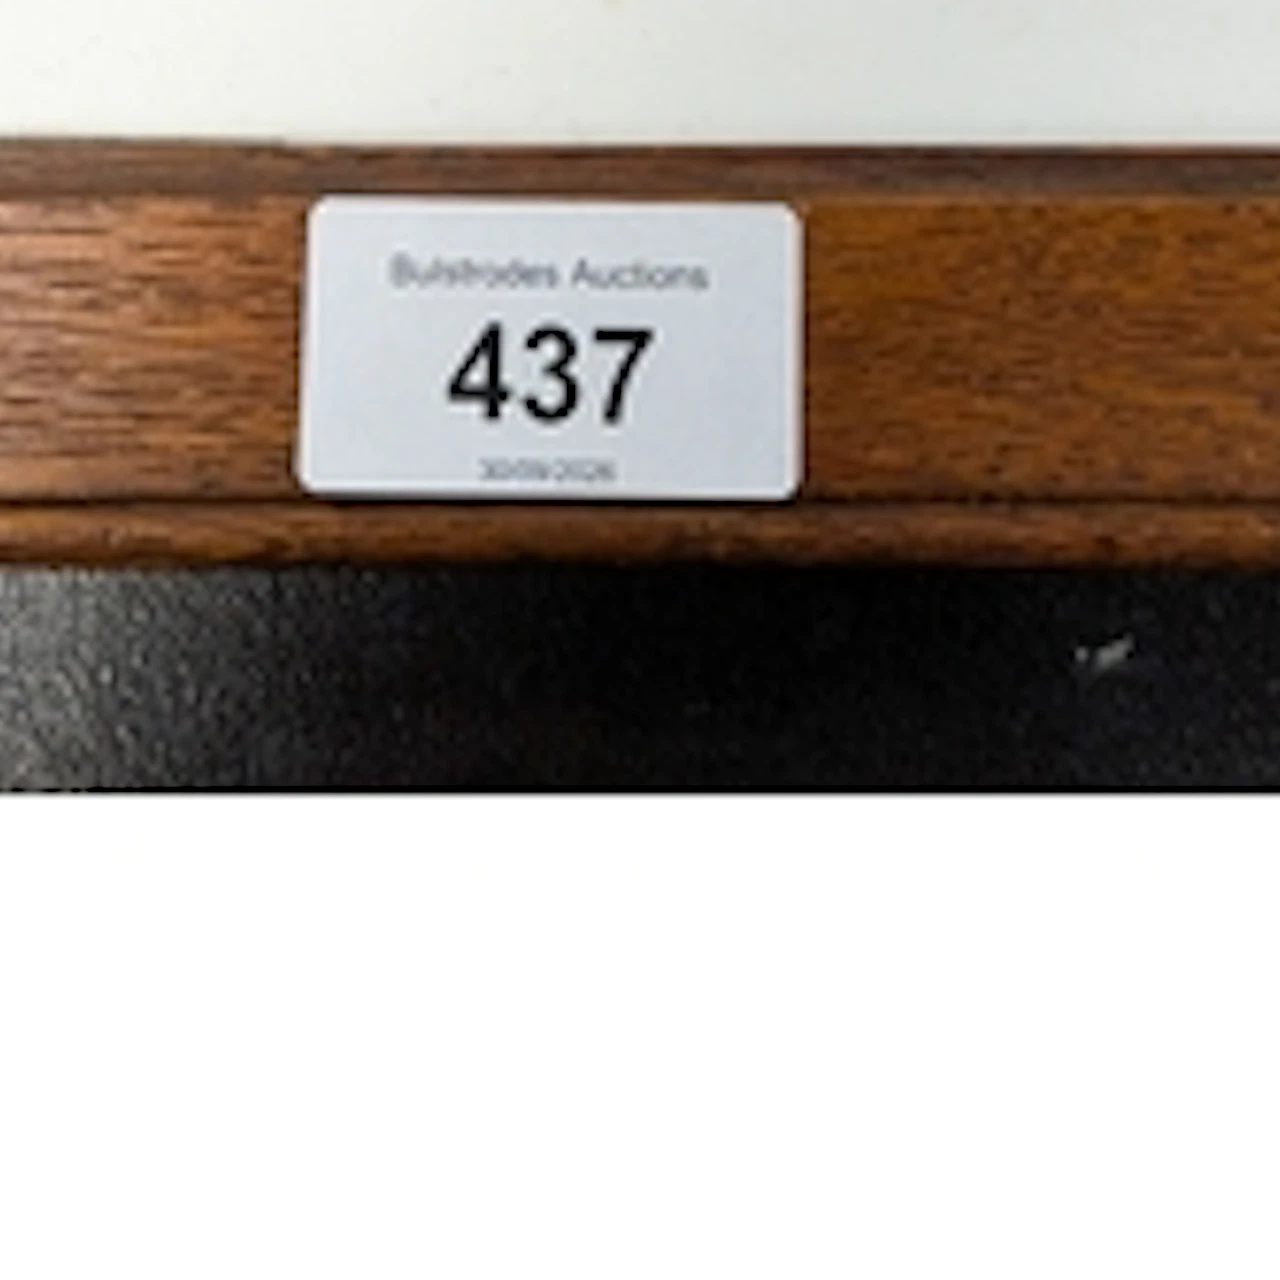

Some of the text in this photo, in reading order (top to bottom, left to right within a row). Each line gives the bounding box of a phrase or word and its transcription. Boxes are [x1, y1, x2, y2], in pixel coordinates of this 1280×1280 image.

[390, 254, 709, 290] Bulstrodes Auctions
[447, 322, 654, 425] 437
